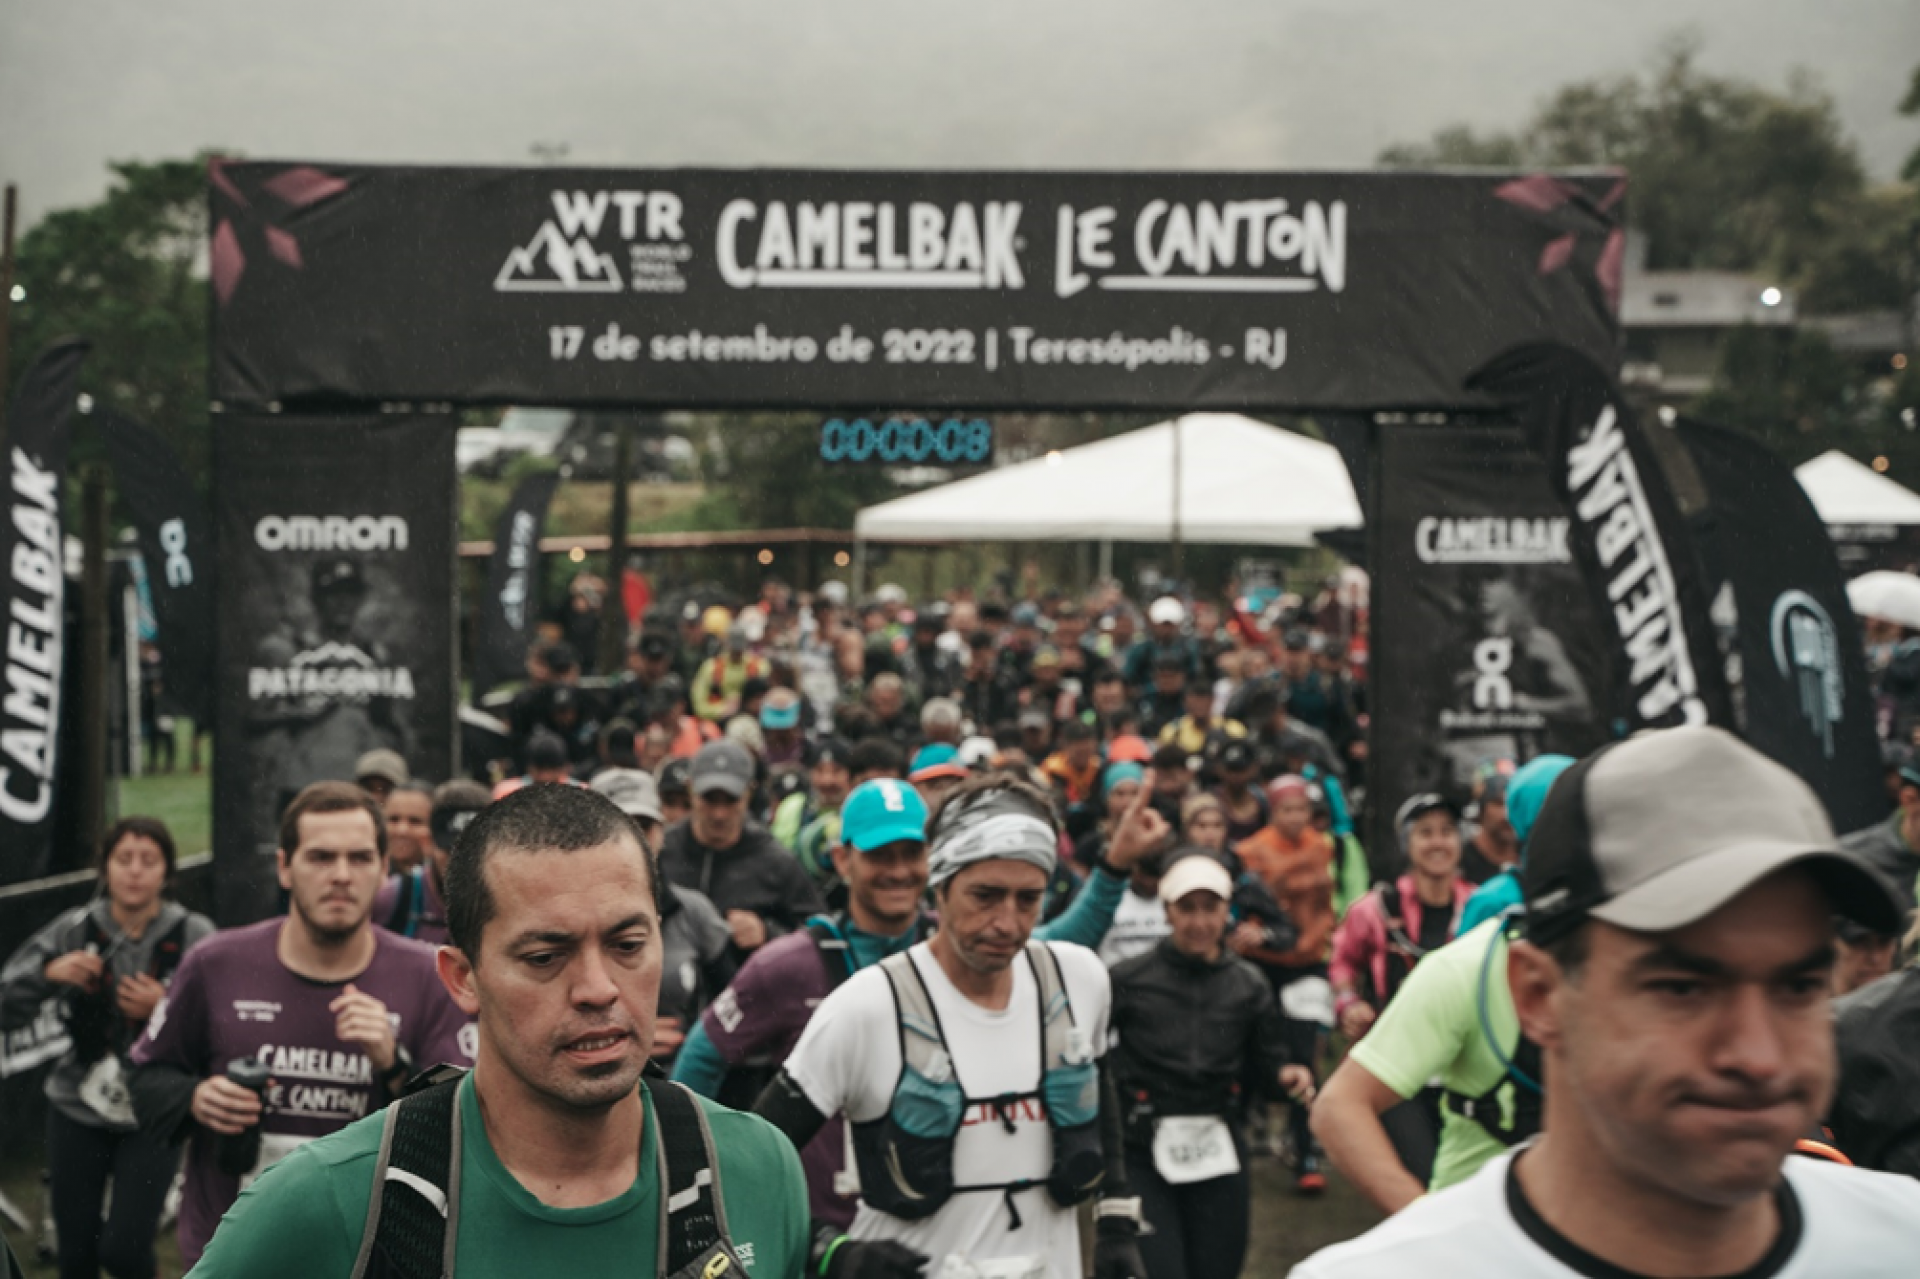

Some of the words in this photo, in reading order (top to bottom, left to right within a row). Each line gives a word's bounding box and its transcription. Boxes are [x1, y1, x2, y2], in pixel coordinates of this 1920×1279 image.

[549, 189, 684, 240] WTR
[715, 199, 1025, 289] CAMELBAK
[1055, 203, 1117, 298] LE
[1134, 198, 1347, 293] CANTON
[549, 325, 585, 361] 17
[592, 321, 641, 362] de
[649, 322, 818, 363] setembro
[826, 322, 874, 364] de
[882, 327, 976, 364] 2022
[1007, 325, 1211, 372] Teresópolis
[1244, 327, 1288, 370] RJ
[1414, 514, 1574, 565] CAMELBAK
[0, 444, 61, 823] CAMELBAK
[248, 665, 416, 700] PATAGONIA
